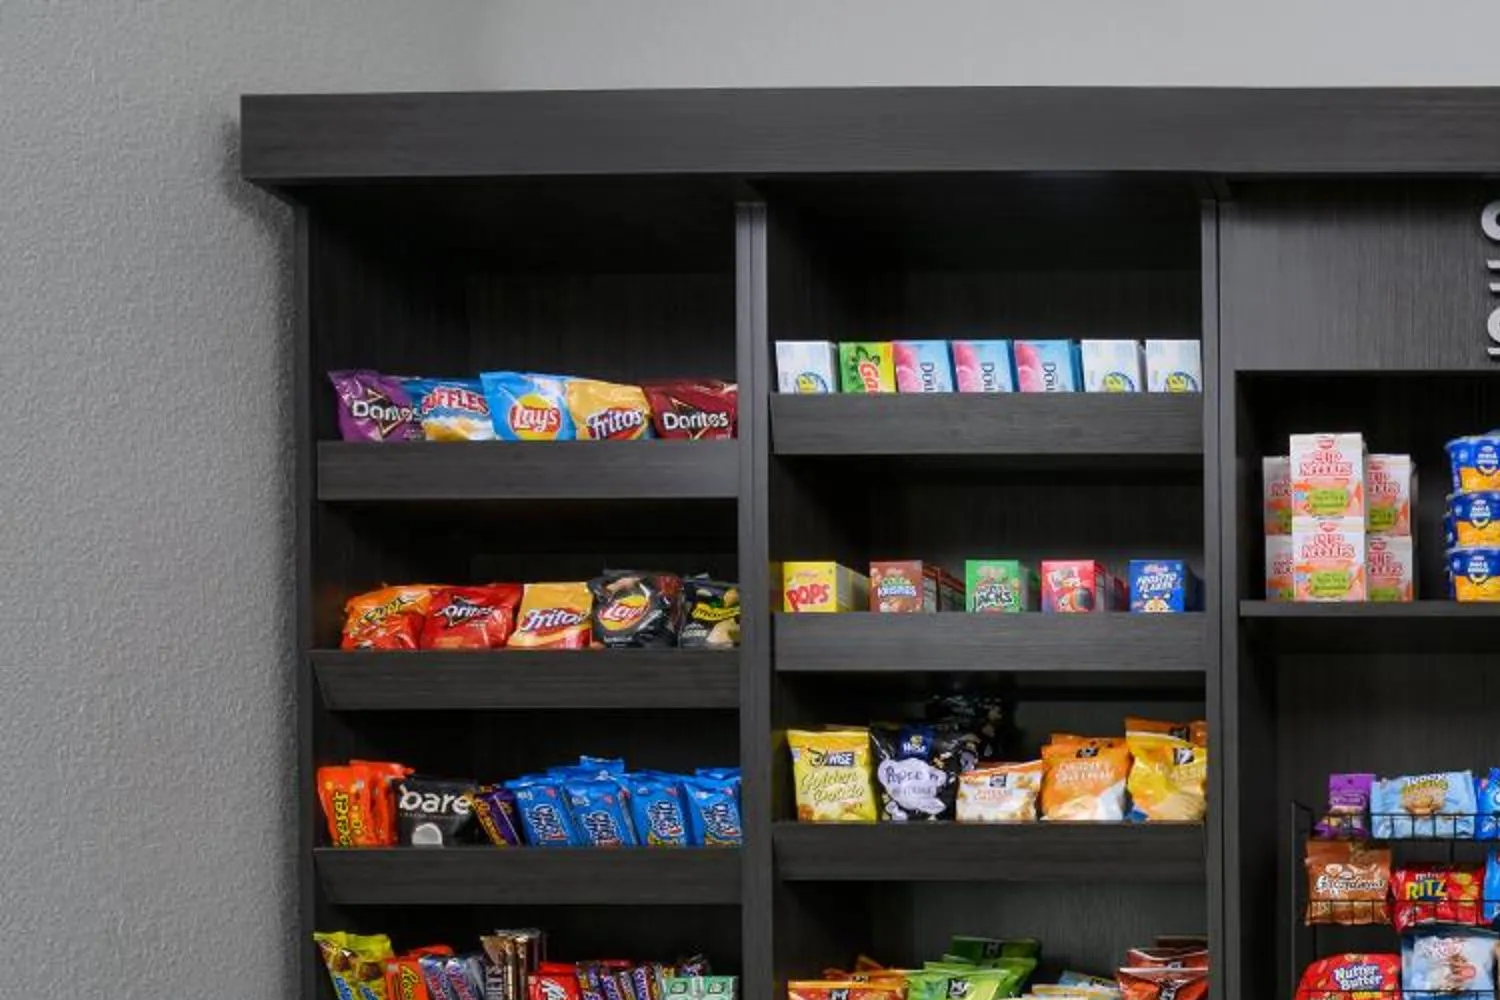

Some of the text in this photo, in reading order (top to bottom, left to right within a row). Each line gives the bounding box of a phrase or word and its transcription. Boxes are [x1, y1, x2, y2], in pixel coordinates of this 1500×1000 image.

[662, 410, 729, 431] Doritos
[400, 783, 471, 815] bare
[1406, 879, 1448, 900] RITZ
